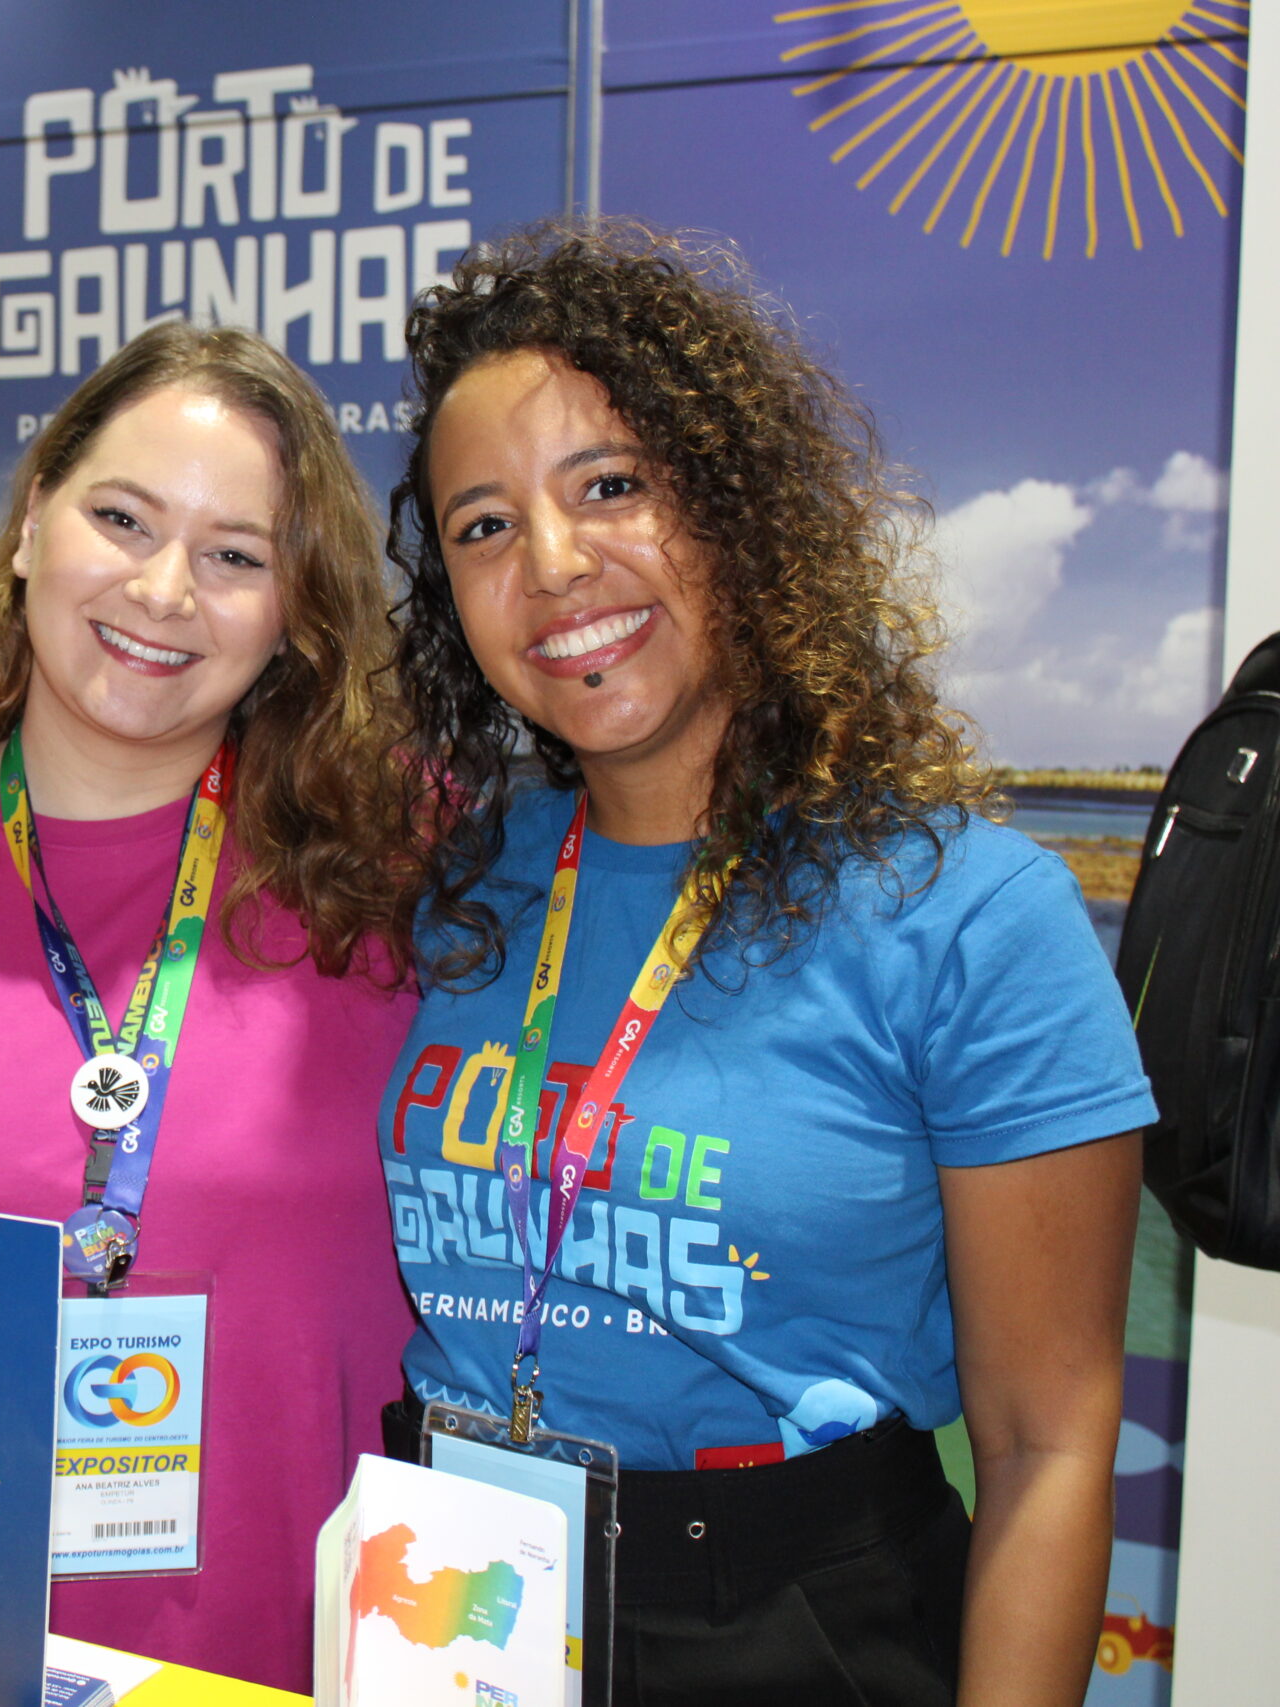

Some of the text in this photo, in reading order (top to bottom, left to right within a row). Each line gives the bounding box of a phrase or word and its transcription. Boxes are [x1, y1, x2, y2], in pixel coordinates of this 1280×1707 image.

[24, 64, 471, 240] PORTO DE
[66, 941, 117, 1057] EMPETU
[639, 1125, 731, 1211] DE
[383, 1159, 745, 1336] GALINHAS
[410, 1291, 591, 1329] ERNAMBUCO
[70, 1334, 182, 1350] EXPO TURISMO
[55, 1454, 188, 1477] EXPOSITOR
[75, 1483, 93, 1491] ANA
[95, 1481, 131, 1490] BEATRIZ
[475, 1679, 519, 1707] PER
